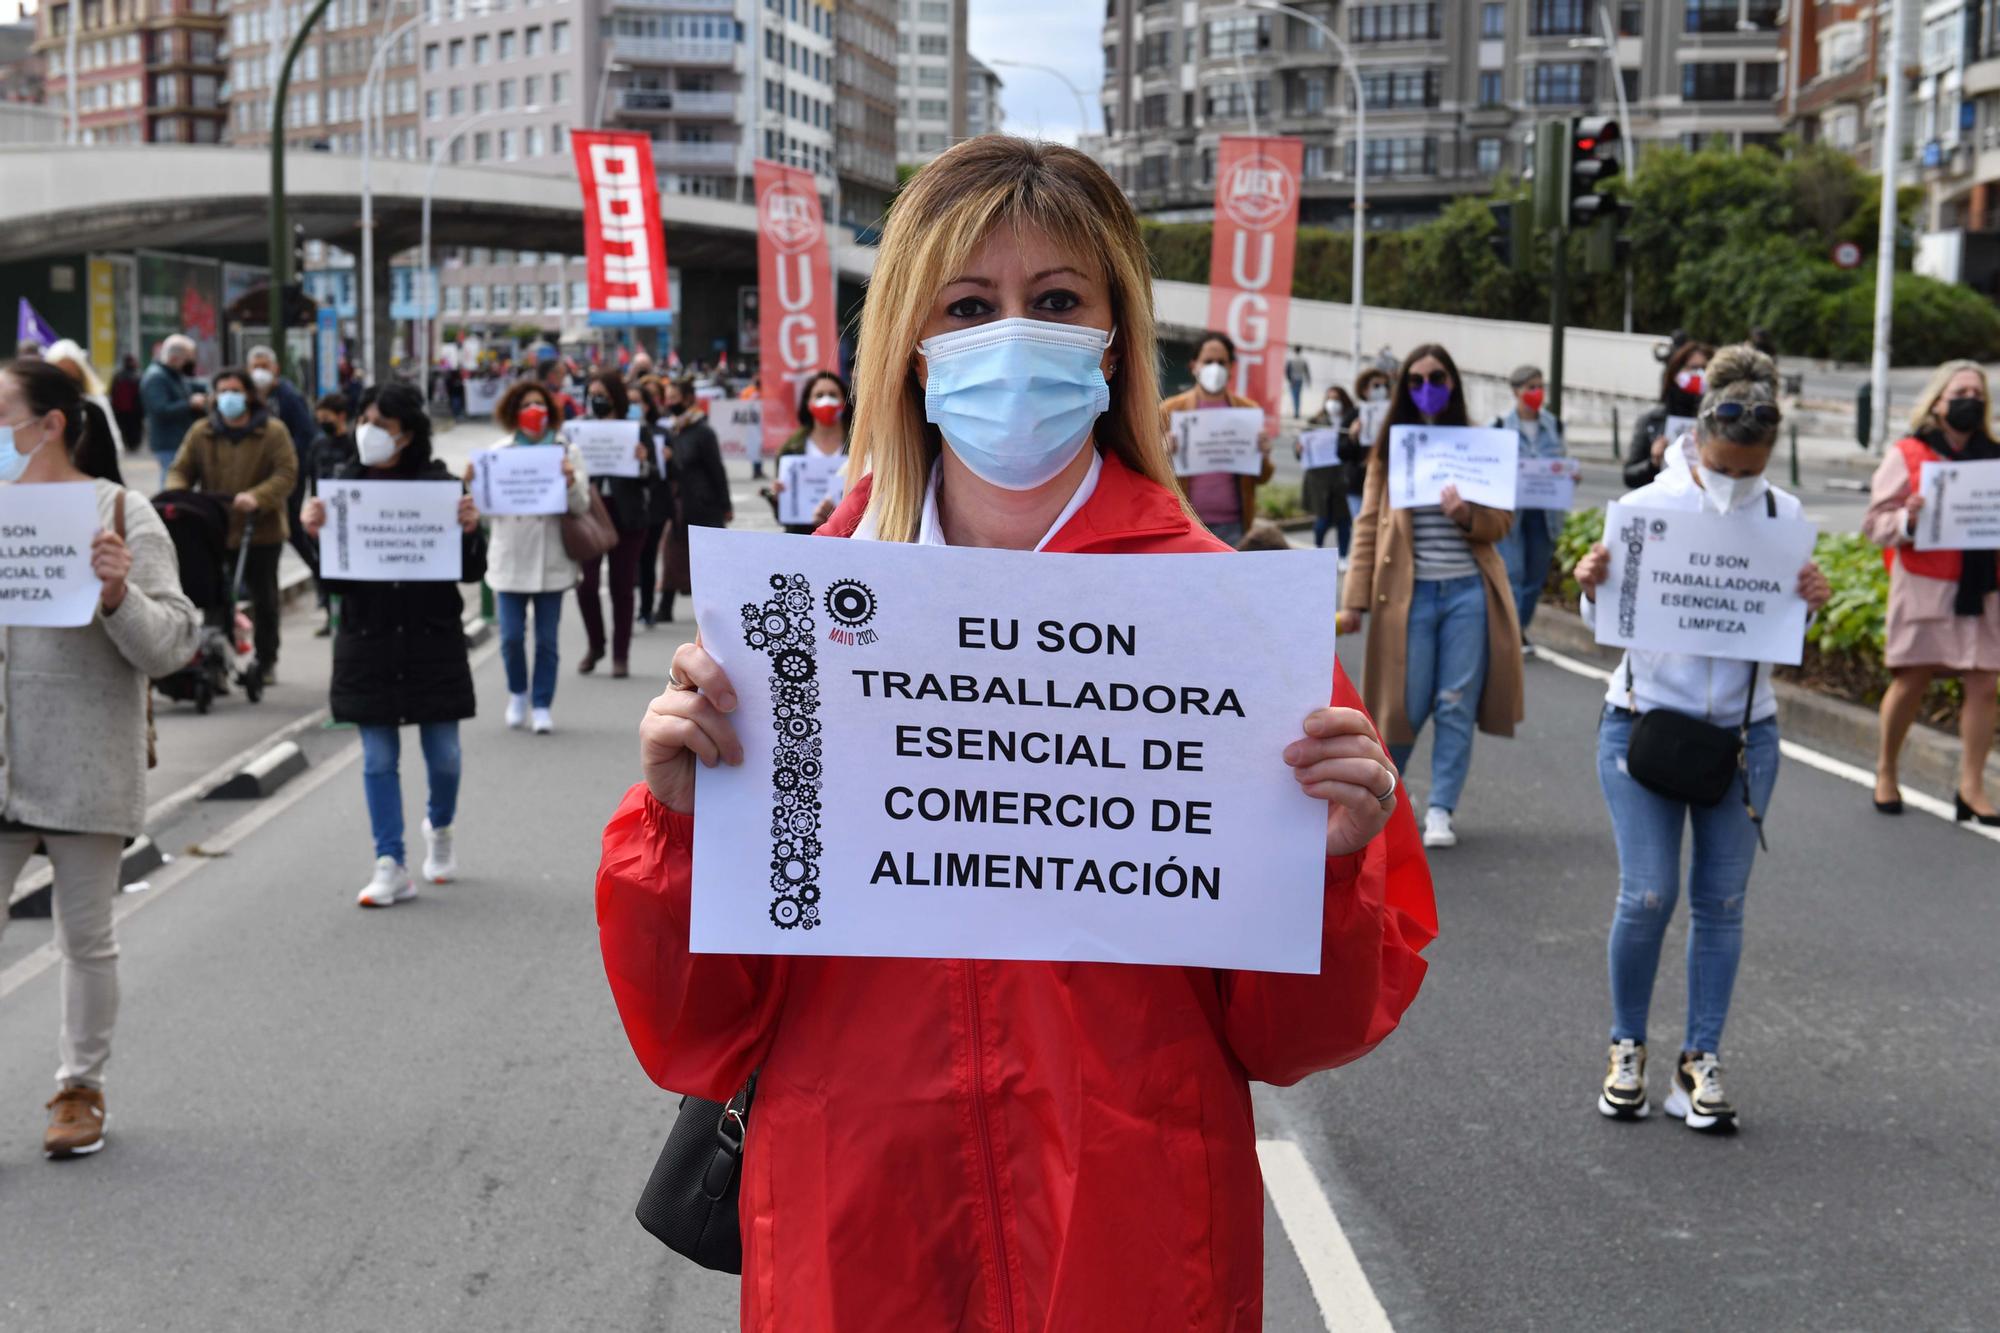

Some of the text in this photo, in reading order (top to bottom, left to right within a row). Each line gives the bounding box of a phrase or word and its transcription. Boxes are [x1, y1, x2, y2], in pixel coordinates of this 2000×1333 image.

[1, 525, 37, 538] SON
[356, 524, 445, 534] TRABALLADORA
[1689, 552, 1750, 570] EU SON
[43, 566, 65, 579] DE
[1651, 571, 1781, 594] TRABALLADORA
[1660, 593, 1766, 615] ESENCIAL DE
[1678, 616, 1747, 634] LIMPEZA
[828, 626, 880, 647] MAIO 2021
[958, 616, 1137, 657] EU SON
[851, 669, 1247, 718] TRABALLADORA
[895, 724, 1205, 772] ESENCIAL DE
[884, 786, 1212, 835] COMERCIO DE
[869, 850, 1221, 901] ALIMENTACIÓN
